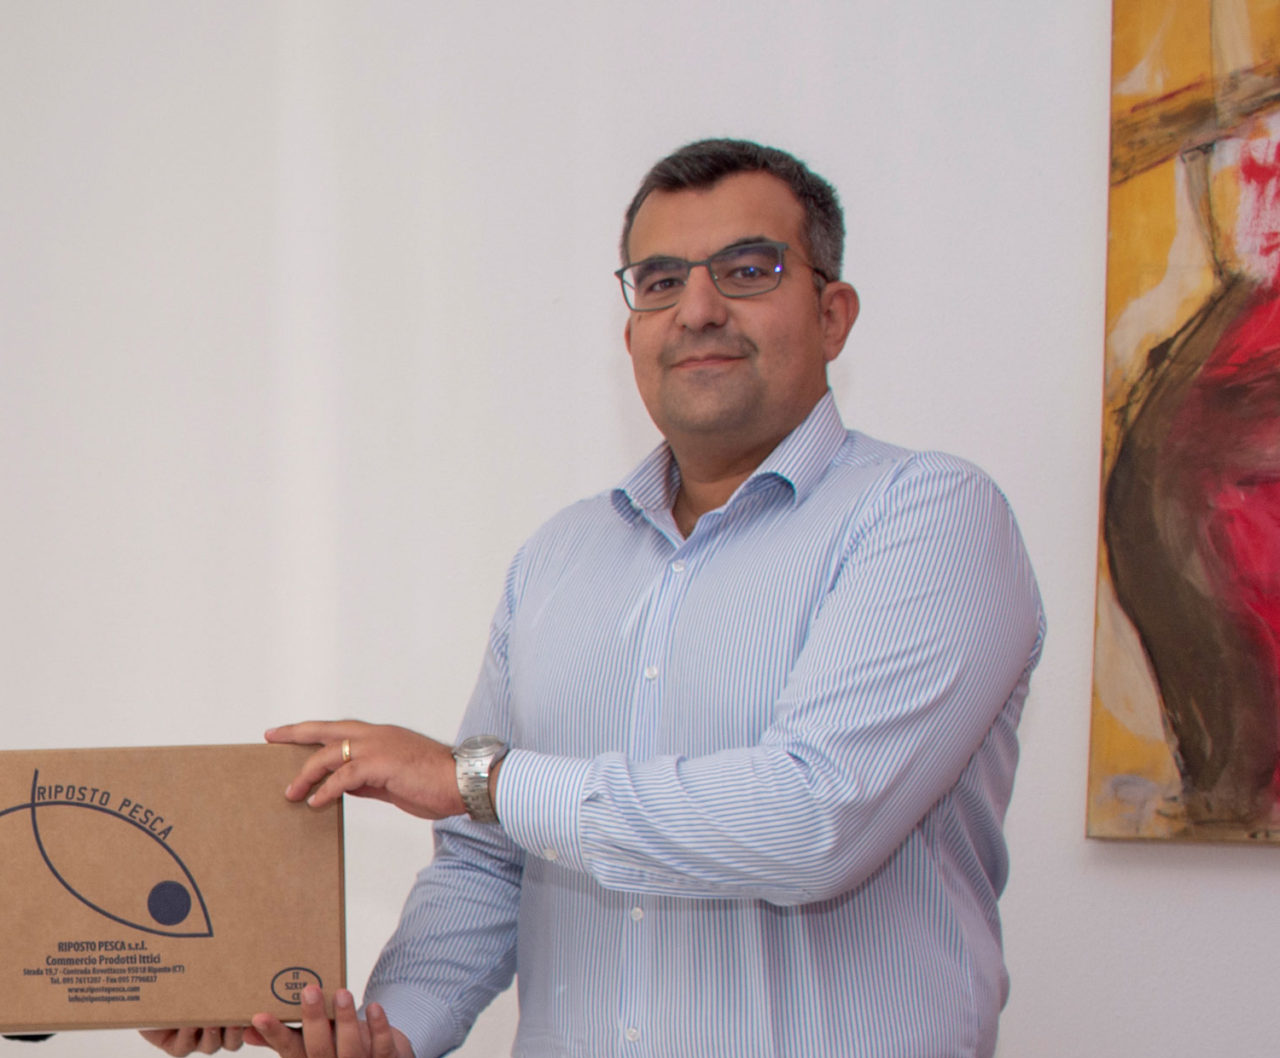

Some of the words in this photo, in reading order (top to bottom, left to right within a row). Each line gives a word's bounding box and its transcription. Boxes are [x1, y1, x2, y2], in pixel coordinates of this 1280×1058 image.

[37, 784, 111, 806] RIPOSTO
[118, 798, 174, 841] PESCA
[57, 941, 96, 952] RIPOSTO
[98, 940, 126, 951] PESCA
[45, 955, 97, 966] Commercio
[99, 954, 137, 965] Prodotti
[139, 953, 161, 964] Ittici
